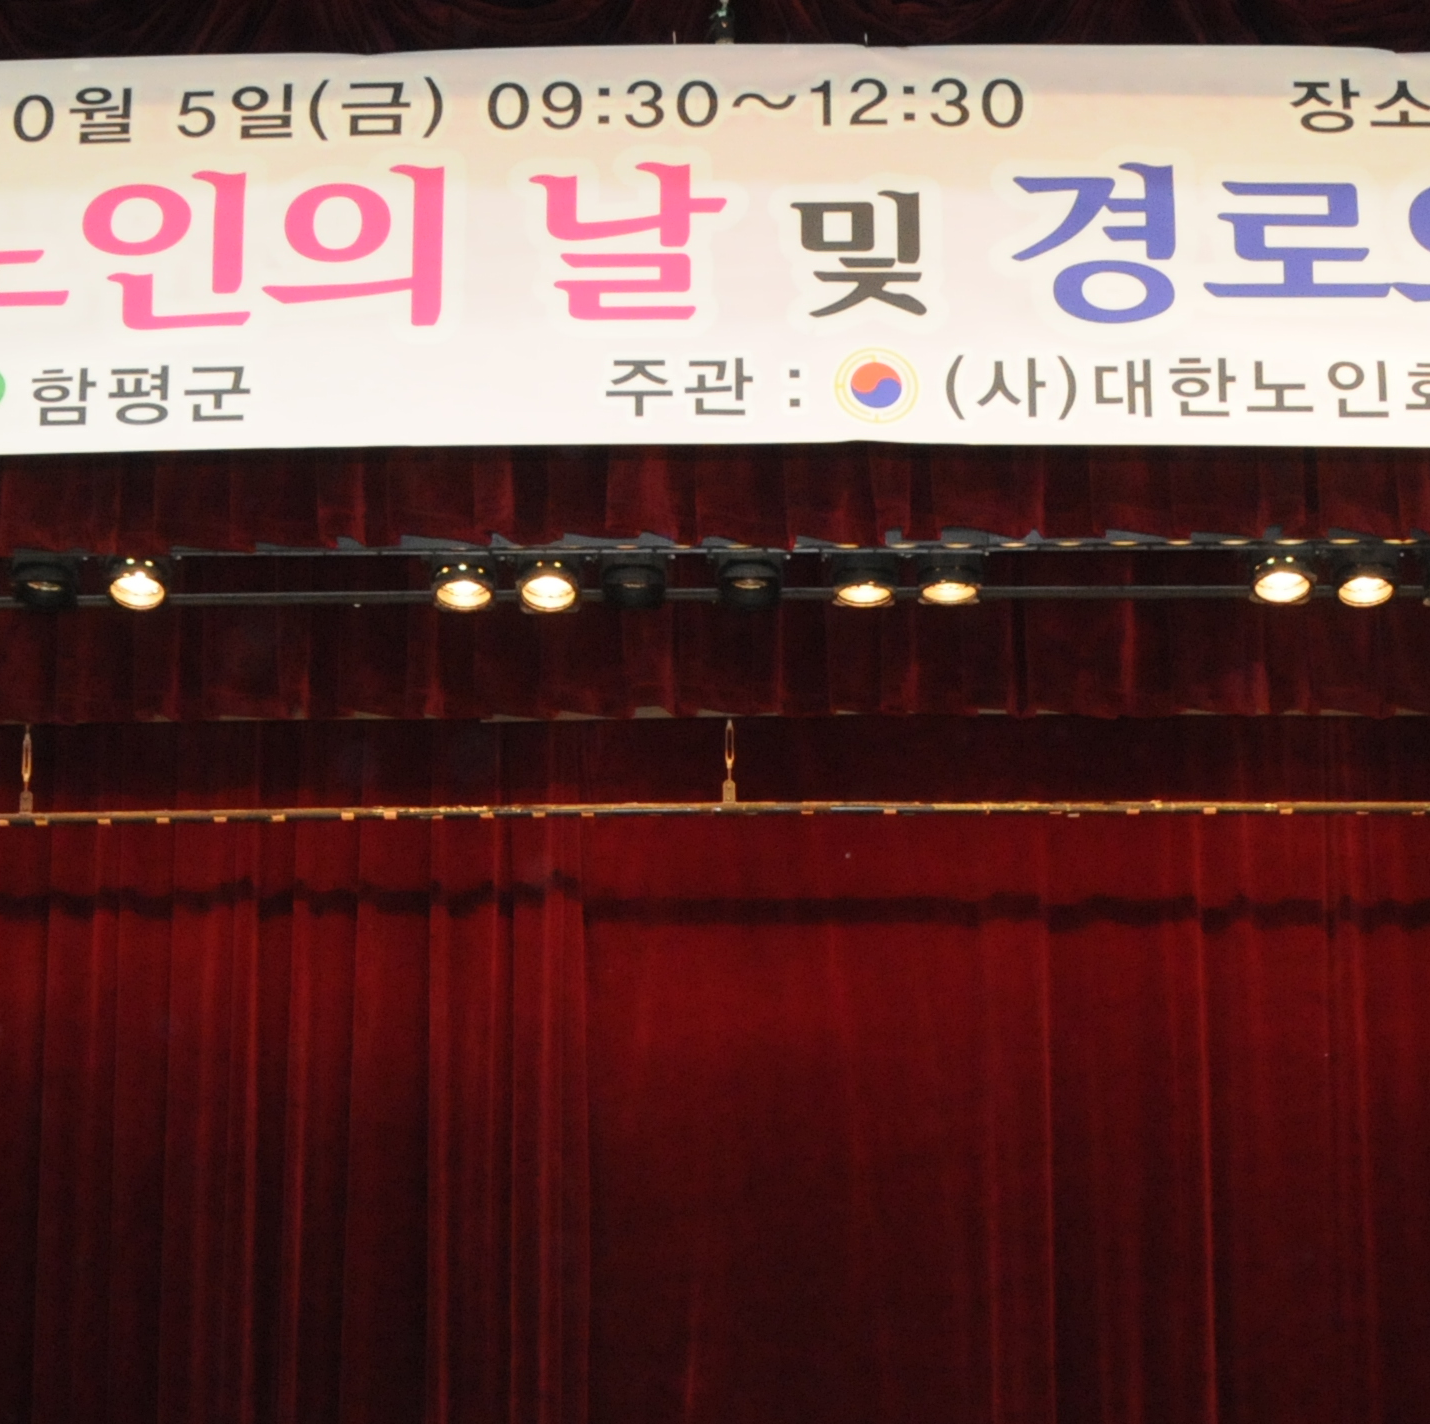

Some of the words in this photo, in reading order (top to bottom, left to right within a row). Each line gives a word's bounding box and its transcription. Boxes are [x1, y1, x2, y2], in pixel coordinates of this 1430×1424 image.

[178, 76, 443, 140] 5일(금)
[529, 161, 728, 321] 날
[791, 190, 927, 317] 및
[32, 365, 251, 426] 함평군
[605, 357, 753, 416] 주관
